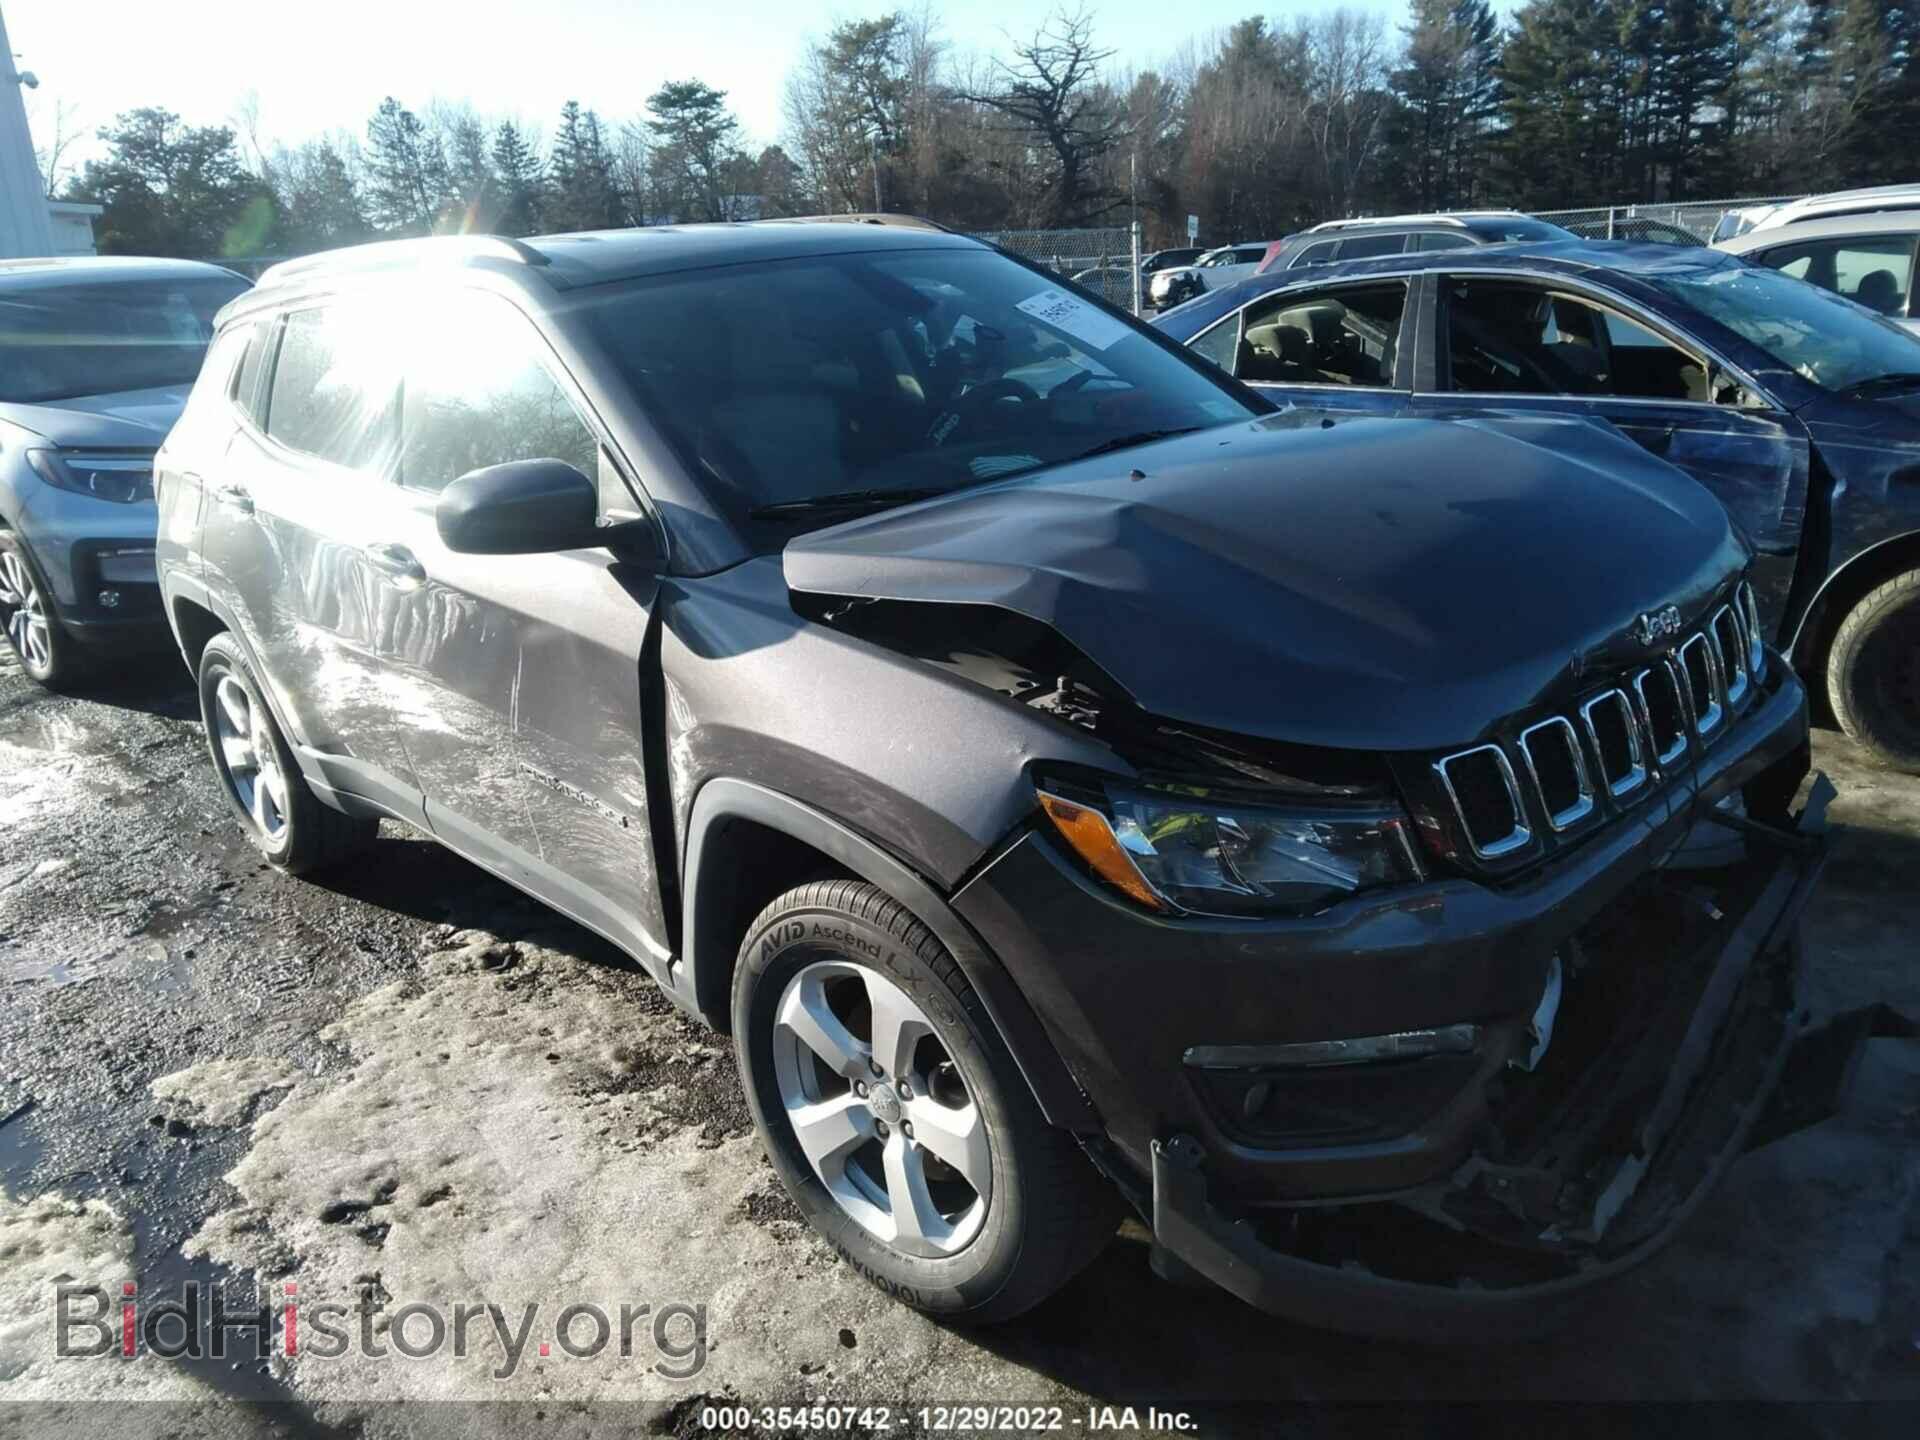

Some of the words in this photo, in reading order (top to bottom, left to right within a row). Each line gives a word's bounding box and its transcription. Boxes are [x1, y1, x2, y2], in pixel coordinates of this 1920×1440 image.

[761, 921, 805, 961] AVID
[812, 923, 881, 958] Ascend
[886, 952, 924, 990] LX
